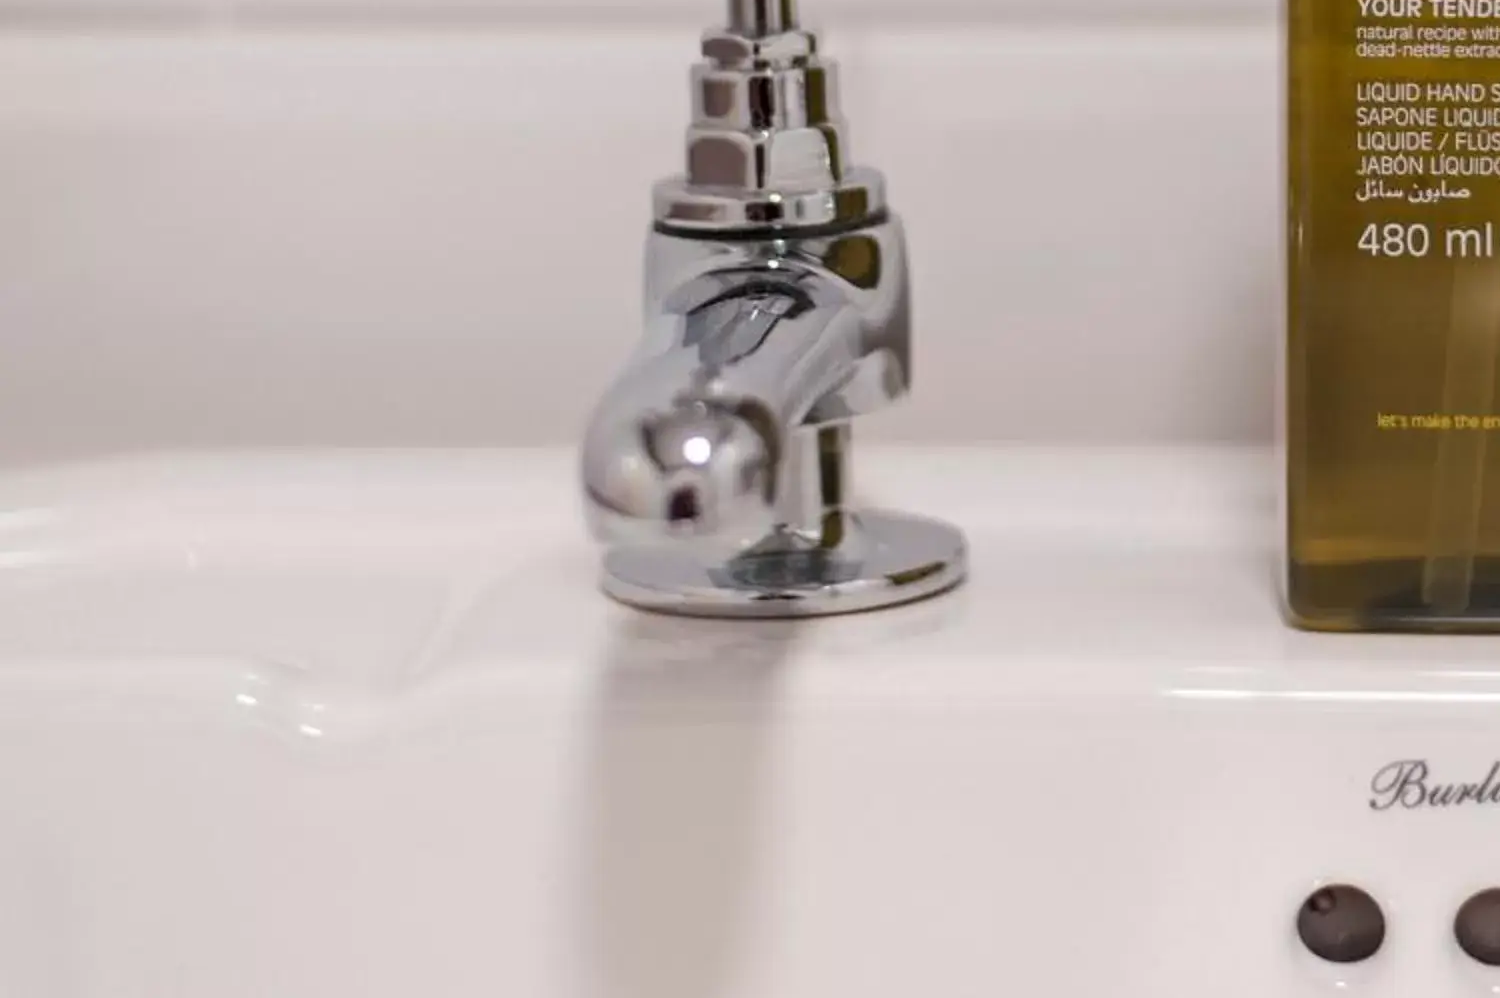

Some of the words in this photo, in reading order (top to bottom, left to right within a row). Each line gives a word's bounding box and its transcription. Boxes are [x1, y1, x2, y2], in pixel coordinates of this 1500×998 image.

[1357, 25, 1412, 41] natural
[1416, 26, 1467, 45] recipe
[1356, 42, 1450, 58] dead-nettle
[1357, 83, 1420, 102] LIQUID
[1427, 83, 1485, 102] HAND
[1357, 107, 1437, 127] SAPONE
[1357, 132, 1433, 151] LIQUIDE
[1356, 152, 1423, 176] JABÓN
[1407, 180, 1472, 203] صابون
[1357, 223, 1430, 257] 480
[1446, 222, 1493, 257] ml
[1377, 412, 1409, 428] let's
[1411, 412, 1450, 428] make
[1454, 412, 1480, 428] the
